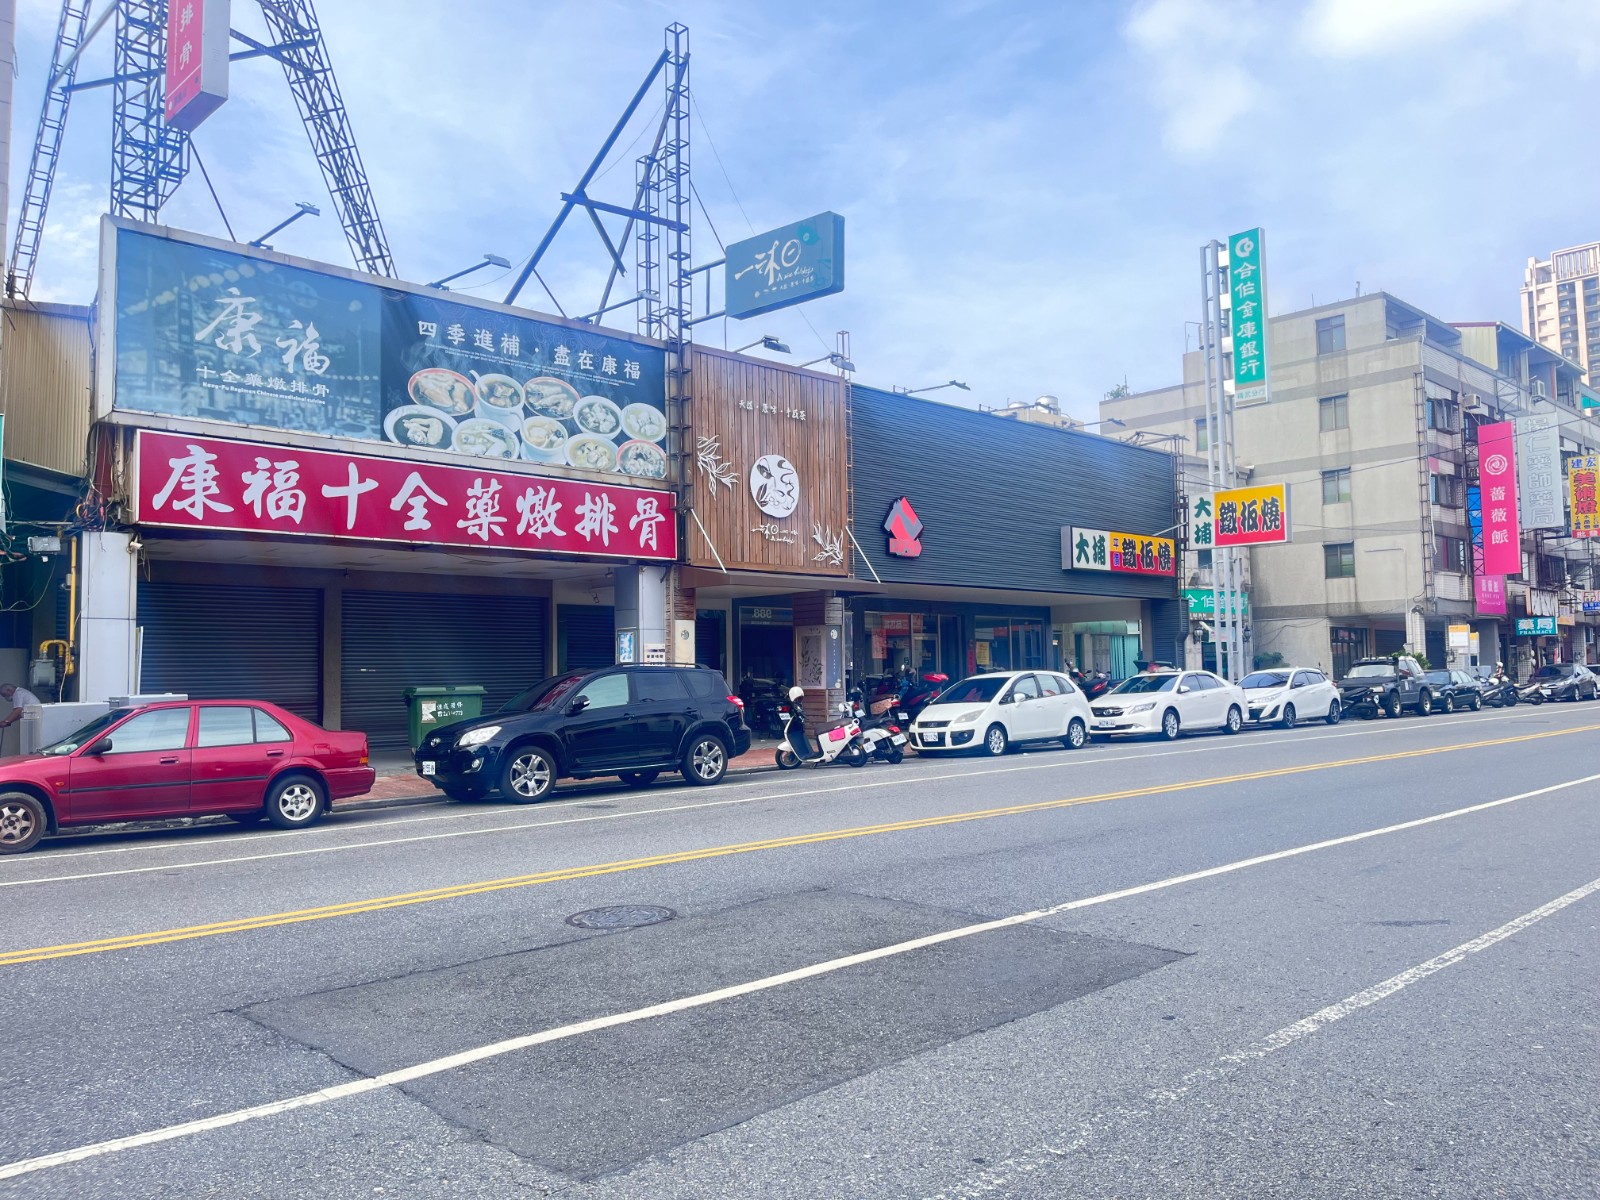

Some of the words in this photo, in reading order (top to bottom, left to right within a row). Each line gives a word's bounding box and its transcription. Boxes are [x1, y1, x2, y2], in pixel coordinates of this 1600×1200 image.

[179, 2, 195, 71] 排骨
[195, 286, 331, 376] 康福
[1234, 262, 1262, 376] 合作金庫銀行
[195, 365, 330, 398] 十全藥燉排骨
[151, 443, 667, 552] 康福十全藥燉排骨
[1218, 496, 1280, 536] 鐵板燒
[1194, 497, 1212, 545] 大埔
[1075, 532, 1107, 566] 大埔
[1121, 537, 1172, 572] 鐵板燒
[1517, 618, 1553, 631] 藥局
